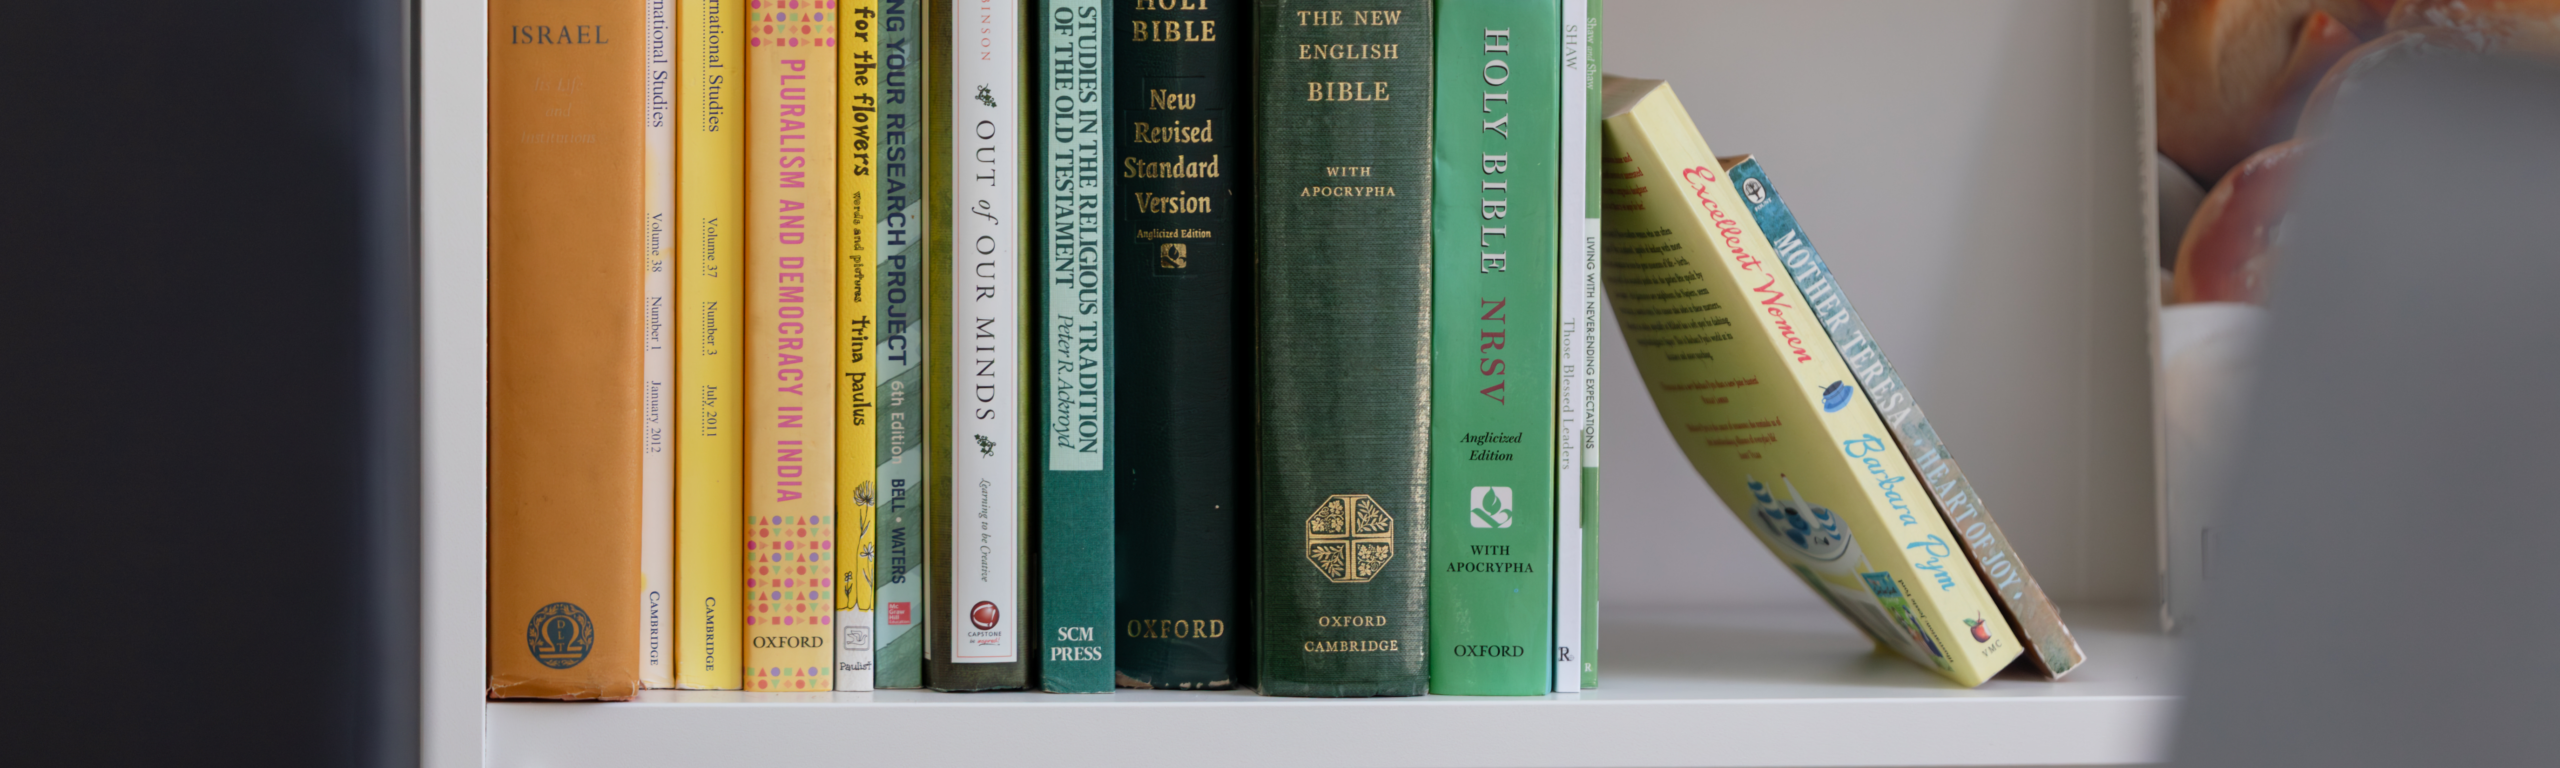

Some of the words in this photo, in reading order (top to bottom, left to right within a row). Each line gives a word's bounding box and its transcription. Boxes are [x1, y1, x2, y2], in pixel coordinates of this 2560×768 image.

[510, 25, 610, 45] ISRAEL
[854, 6, 876, 42] for
[1054, 7, 1074, 36] OF
[1132, 20, 1216, 42] BIBLE
[1297, 10, 1343, 26] THE
[1354, 10, 1402, 26] NEW
[1587, 17, 1597, 44] Shaw
[1078, 6, 1097, 103] STUDIES
[1299, 44, 1399, 60] ENGLISH
[1565, 24, 1578, 71] SHAW
[1587, 45, 1596, 62] and
[853, 51, 877, 86] the
[886, 37, 906, 104] YOUR
[1054, 42, 1074, 91] THE
[1482, 27, 1510, 140] HOLY
[1586, 63, 1597, 90] Shaw
[653, 71, 668, 128] Studies
[709, 75, 724, 132] Studies
[1149, 88, 1196, 110] New
[1307, 81, 1390, 102] BIBLE
[545, 102, 572, 118] and
[779, 59, 806, 188] PLURALISM
[1054, 95, 1074, 143] OLD
[1079, 108, 1098, 134] IN
[852, 93, 876, 176] flowers
[1134, 119, 1213, 143] Revised
[976, 120, 996, 187] OUT
[1079, 140, 1098, 188] THE
[1124, 154, 1220, 179] Standard
[886, 114, 907, 246] RESEARCH
[1326, 166, 1371, 177] WITH
[853, 191, 864, 225] words
[1134, 190, 1212, 214] Version
[1300, 186, 1396, 197] APOCRYPHA
[779, 199, 805, 245] AND
[971, 200, 999, 225] of
[1054, 149, 1075, 289] TESTAMENT
[1480, 152, 1508, 274] BIBLE
[651, 213, 663, 257] Volume
[707, 218, 718, 261] Volume
[853, 228, 865, 251] and
[1136, 228, 1179, 241] Anglicized
[1181, 228, 1212, 239] Edition
[651, 260, 662, 273] 38
[976, 235, 996, 302] OUR
[1079, 193, 1098, 316] RELIGIOUS
[1586, 236, 1596, 270] LIVING
[1683, 166, 1762, 271] Excellent
[1753, 273, 1812, 364] Women
[707, 264, 718, 278] 37
[849, 254, 865, 304] pictures
[1586, 273, 1596, 298] WITH
[651, 296, 662, 342] Number
[707, 302, 718, 347] Number
[778, 256, 804, 396] DEMOCRACY
[887, 255, 907, 366] PROJECT
[1058, 314, 1074, 359] Peter
[1479, 297, 1506, 406] NRSV
[1563, 317, 1576, 360] Those
[1586, 301, 1595, 376] NEVER-ENDING
[975, 317, 996, 420] MINDS
[1057, 360, 1074, 375] R.
[650, 380, 662, 425] January
[704, 385, 718, 408] July
[891, 380, 905, 406] 6th
[1078, 321, 1098, 454] TRADITION
[1562, 364, 1575, 413] Blessed
[707, 411, 718, 437] 2011
[778, 407, 803, 428] IN
[1053, 376, 1075, 449] Ackroyd
[1585, 378, 1596, 449] EXPECTATIONS
[1773, 229, 1850, 333] MOTHER
[1842, 329, 1912, 429] TERESA
[1917, 447, 1978, 523] HEART
[1965, 521, 1995, 550] OF
[1981, 551, 2022, 591] JOY
[651, 428, 662, 453] 2012
[891, 412, 905, 464] Edition
[1460, 432, 1523, 446] Anglicized
[1469, 450, 1514, 461] Edition
[1561, 418, 1575, 470] Leaders
[777, 440, 803, 502] INDIA
[891, 479, 906, 513] BELL
[978, 477, 992, 519] Learning
[1843, 433, 1918, 527] Barbara
[1907, 534, 1956, 592] Pym
[981, 522, 989, 531] to
[981, 533, 992, 544] be
[891, 527, 906, 584] WATERS
[980, 545, 992, 583] Creative
[1446, 562, 1534, 573] APOCRYPHA
[1470, 545, 1511, 556] WITH
[649, 591, 661, 666] CAMBRIDGE
[705, 597, 716, 672] CAMBRIDGE
[1058, 626, 1094, 642] SCM
[1127, 619, 1225, 639] OXFORD
[1318, 615, 1387, 627] OXFORD
[753, 635, 824, 649] OXFORD
[1050, 646, 1103, 662] PRESS
[1304, 639, 1399, 653] CAMBRIDGE
[1453, 645, 1525, 658] OXFORD
[839, 660, 873, 672] Paulist
[1584, 662, 1593, 672] R
